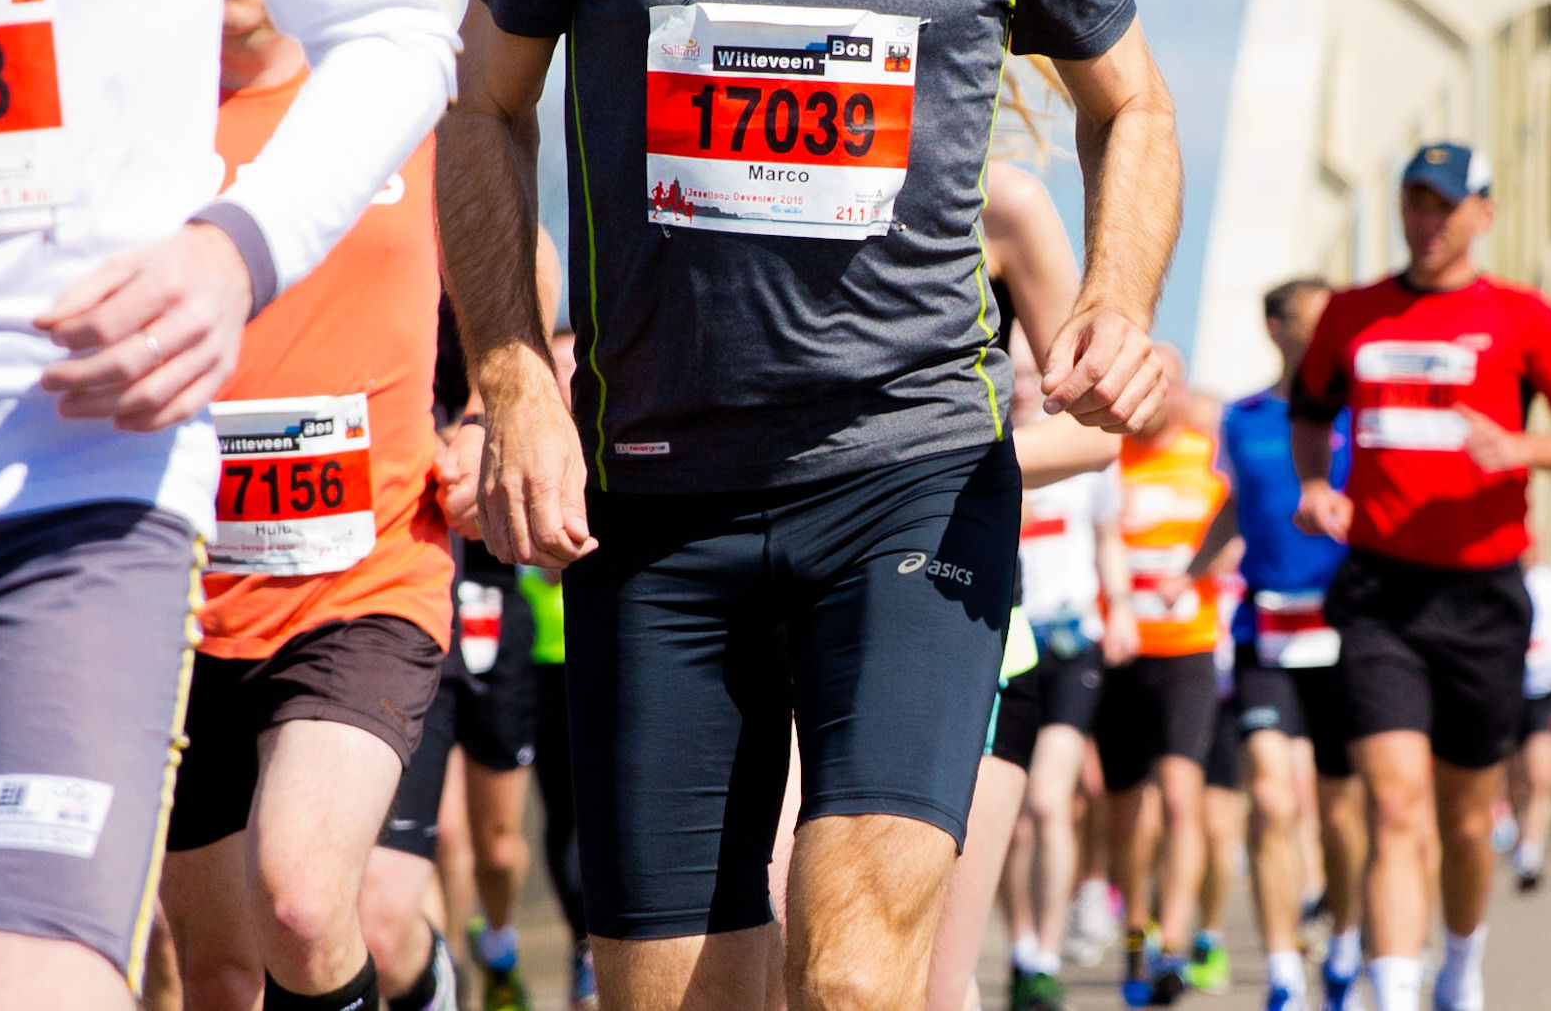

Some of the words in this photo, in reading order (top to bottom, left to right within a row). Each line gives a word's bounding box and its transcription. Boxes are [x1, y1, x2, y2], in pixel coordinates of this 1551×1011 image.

[832, 40, 870, 57] Bos
[717, 51, 814, 70] Witteveen
[691, 85, 875, 157] 17039
[749, 165, 809, 183] Marco
[304, 420, 332, 436] Bos
[226, 460, 344, 514] 7156
[927, 560, 974, 586] asics
